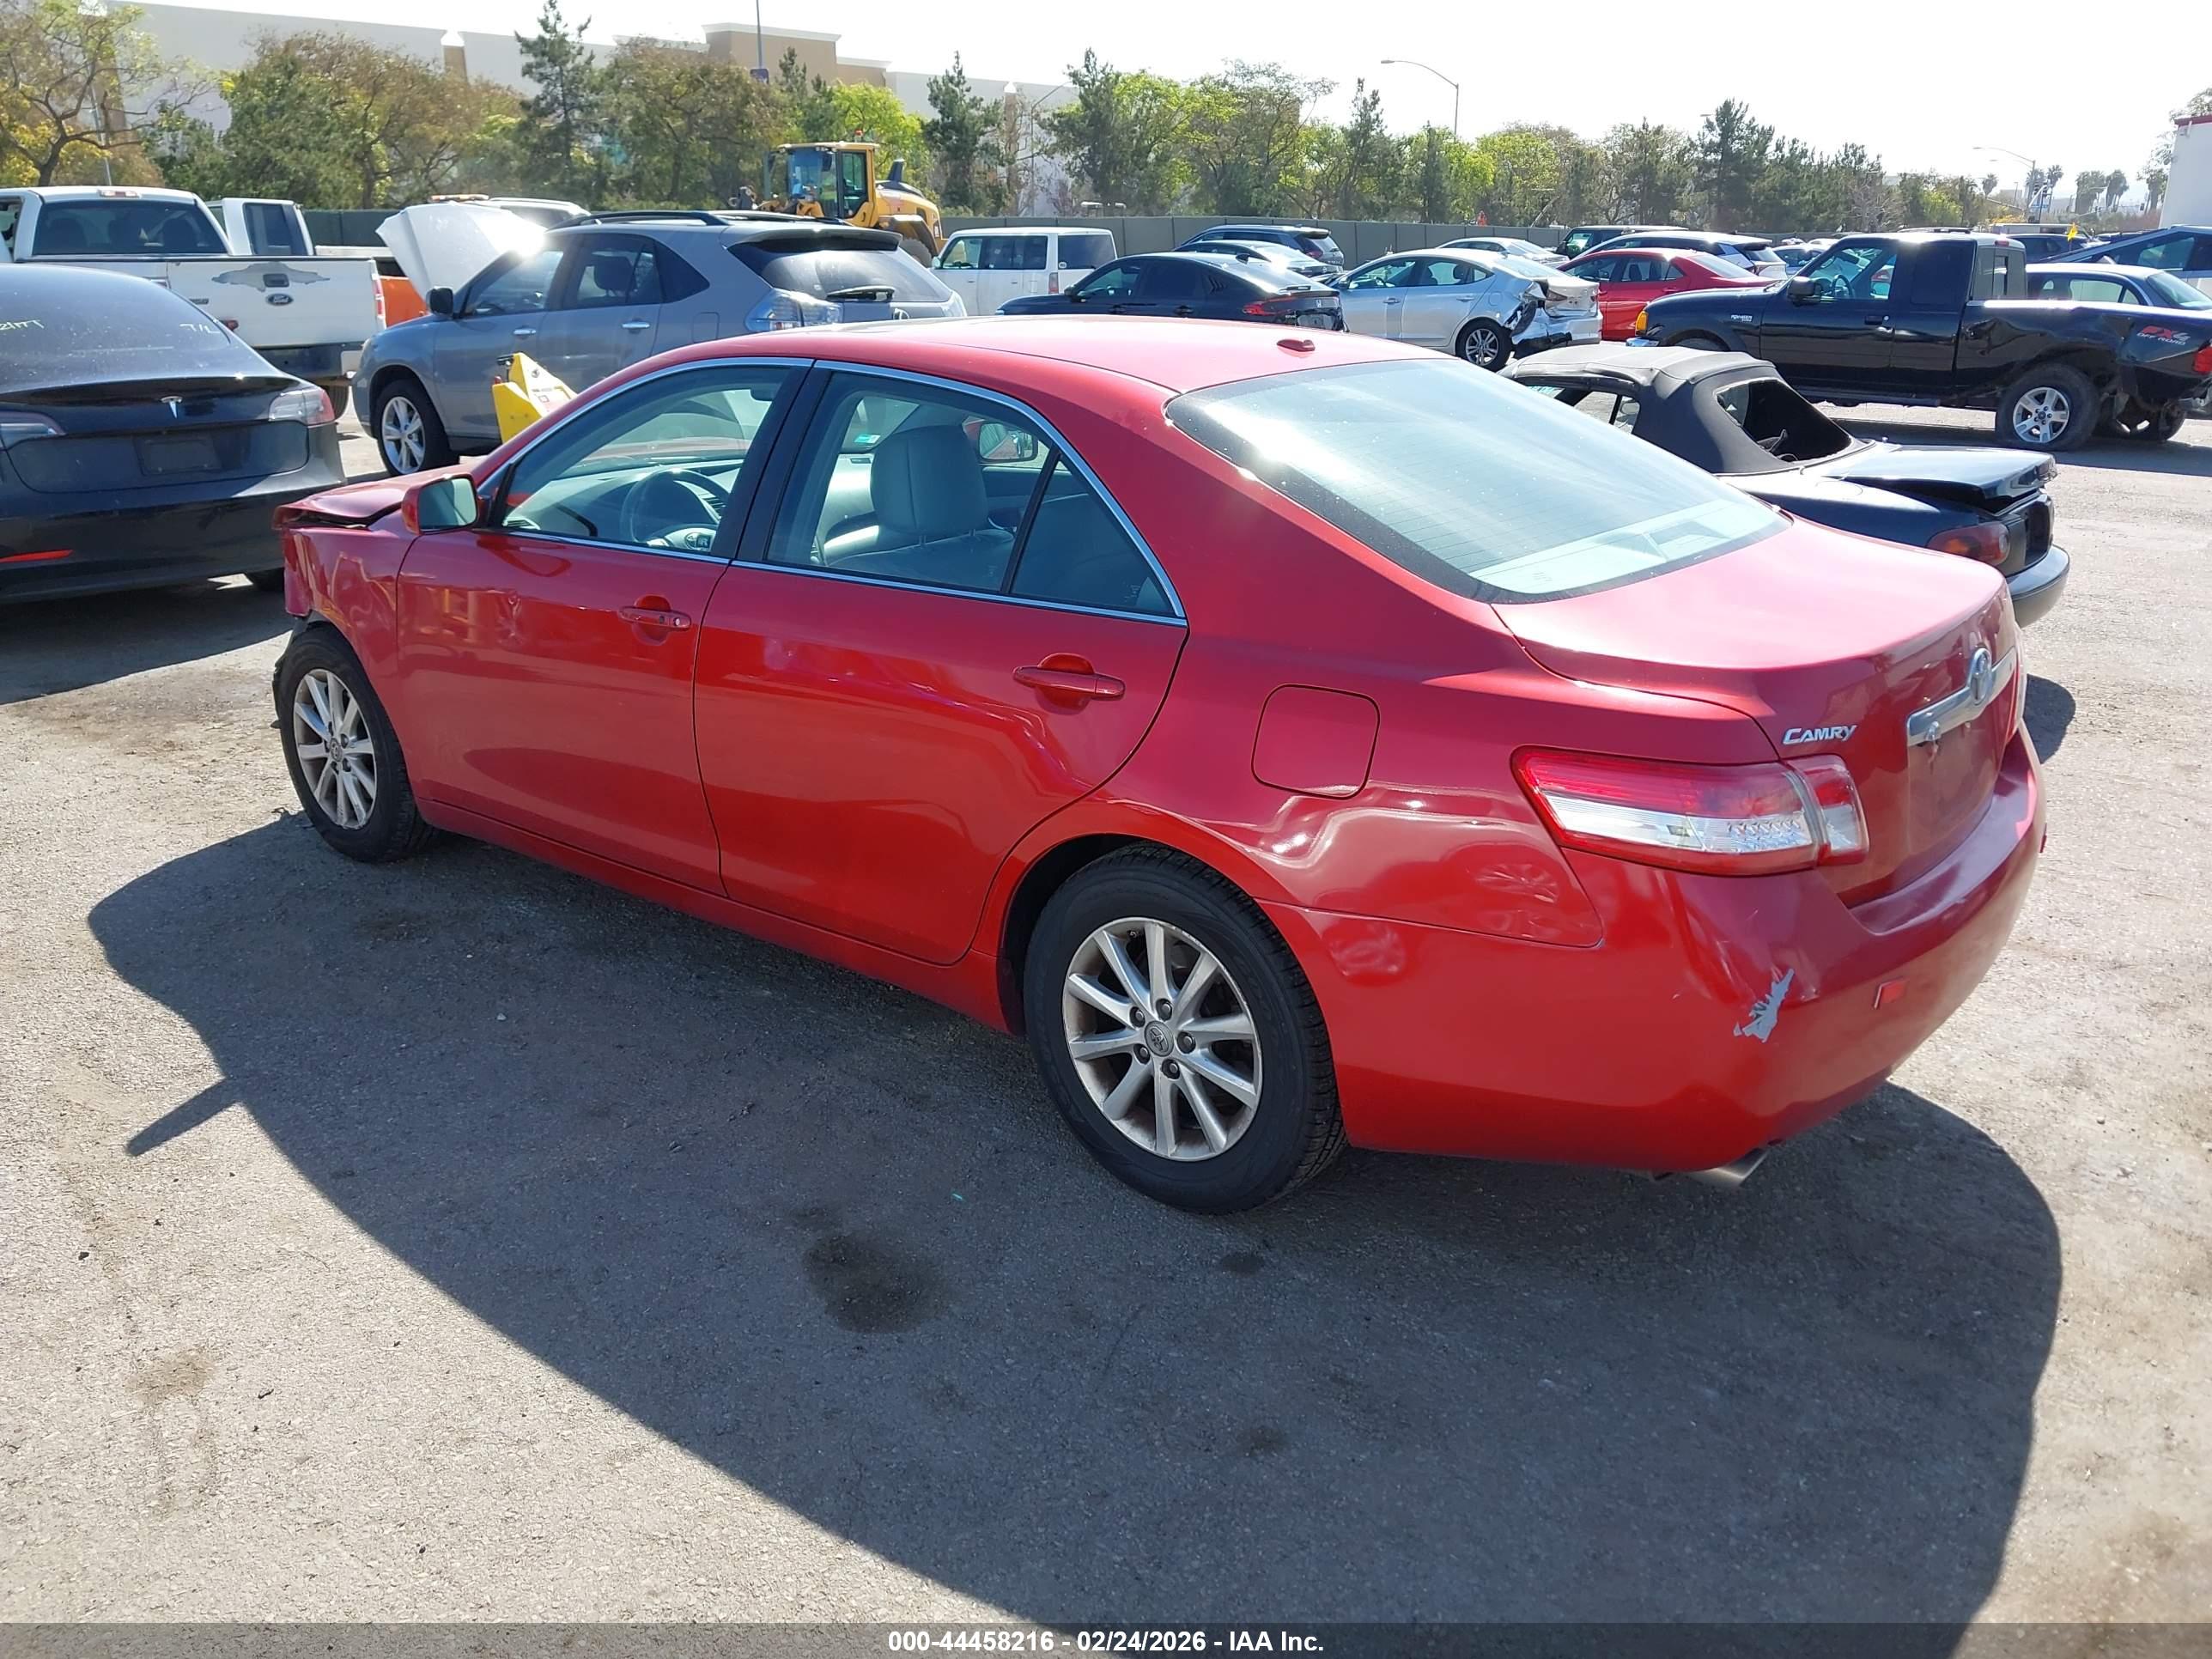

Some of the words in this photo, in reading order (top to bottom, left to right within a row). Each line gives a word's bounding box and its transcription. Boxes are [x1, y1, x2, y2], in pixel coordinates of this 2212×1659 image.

[2142, 326, 2191, 341] FX4
[2157, 337, 2186, 345] ROAD
[1783, 725, 1857, 744] CAMRY
